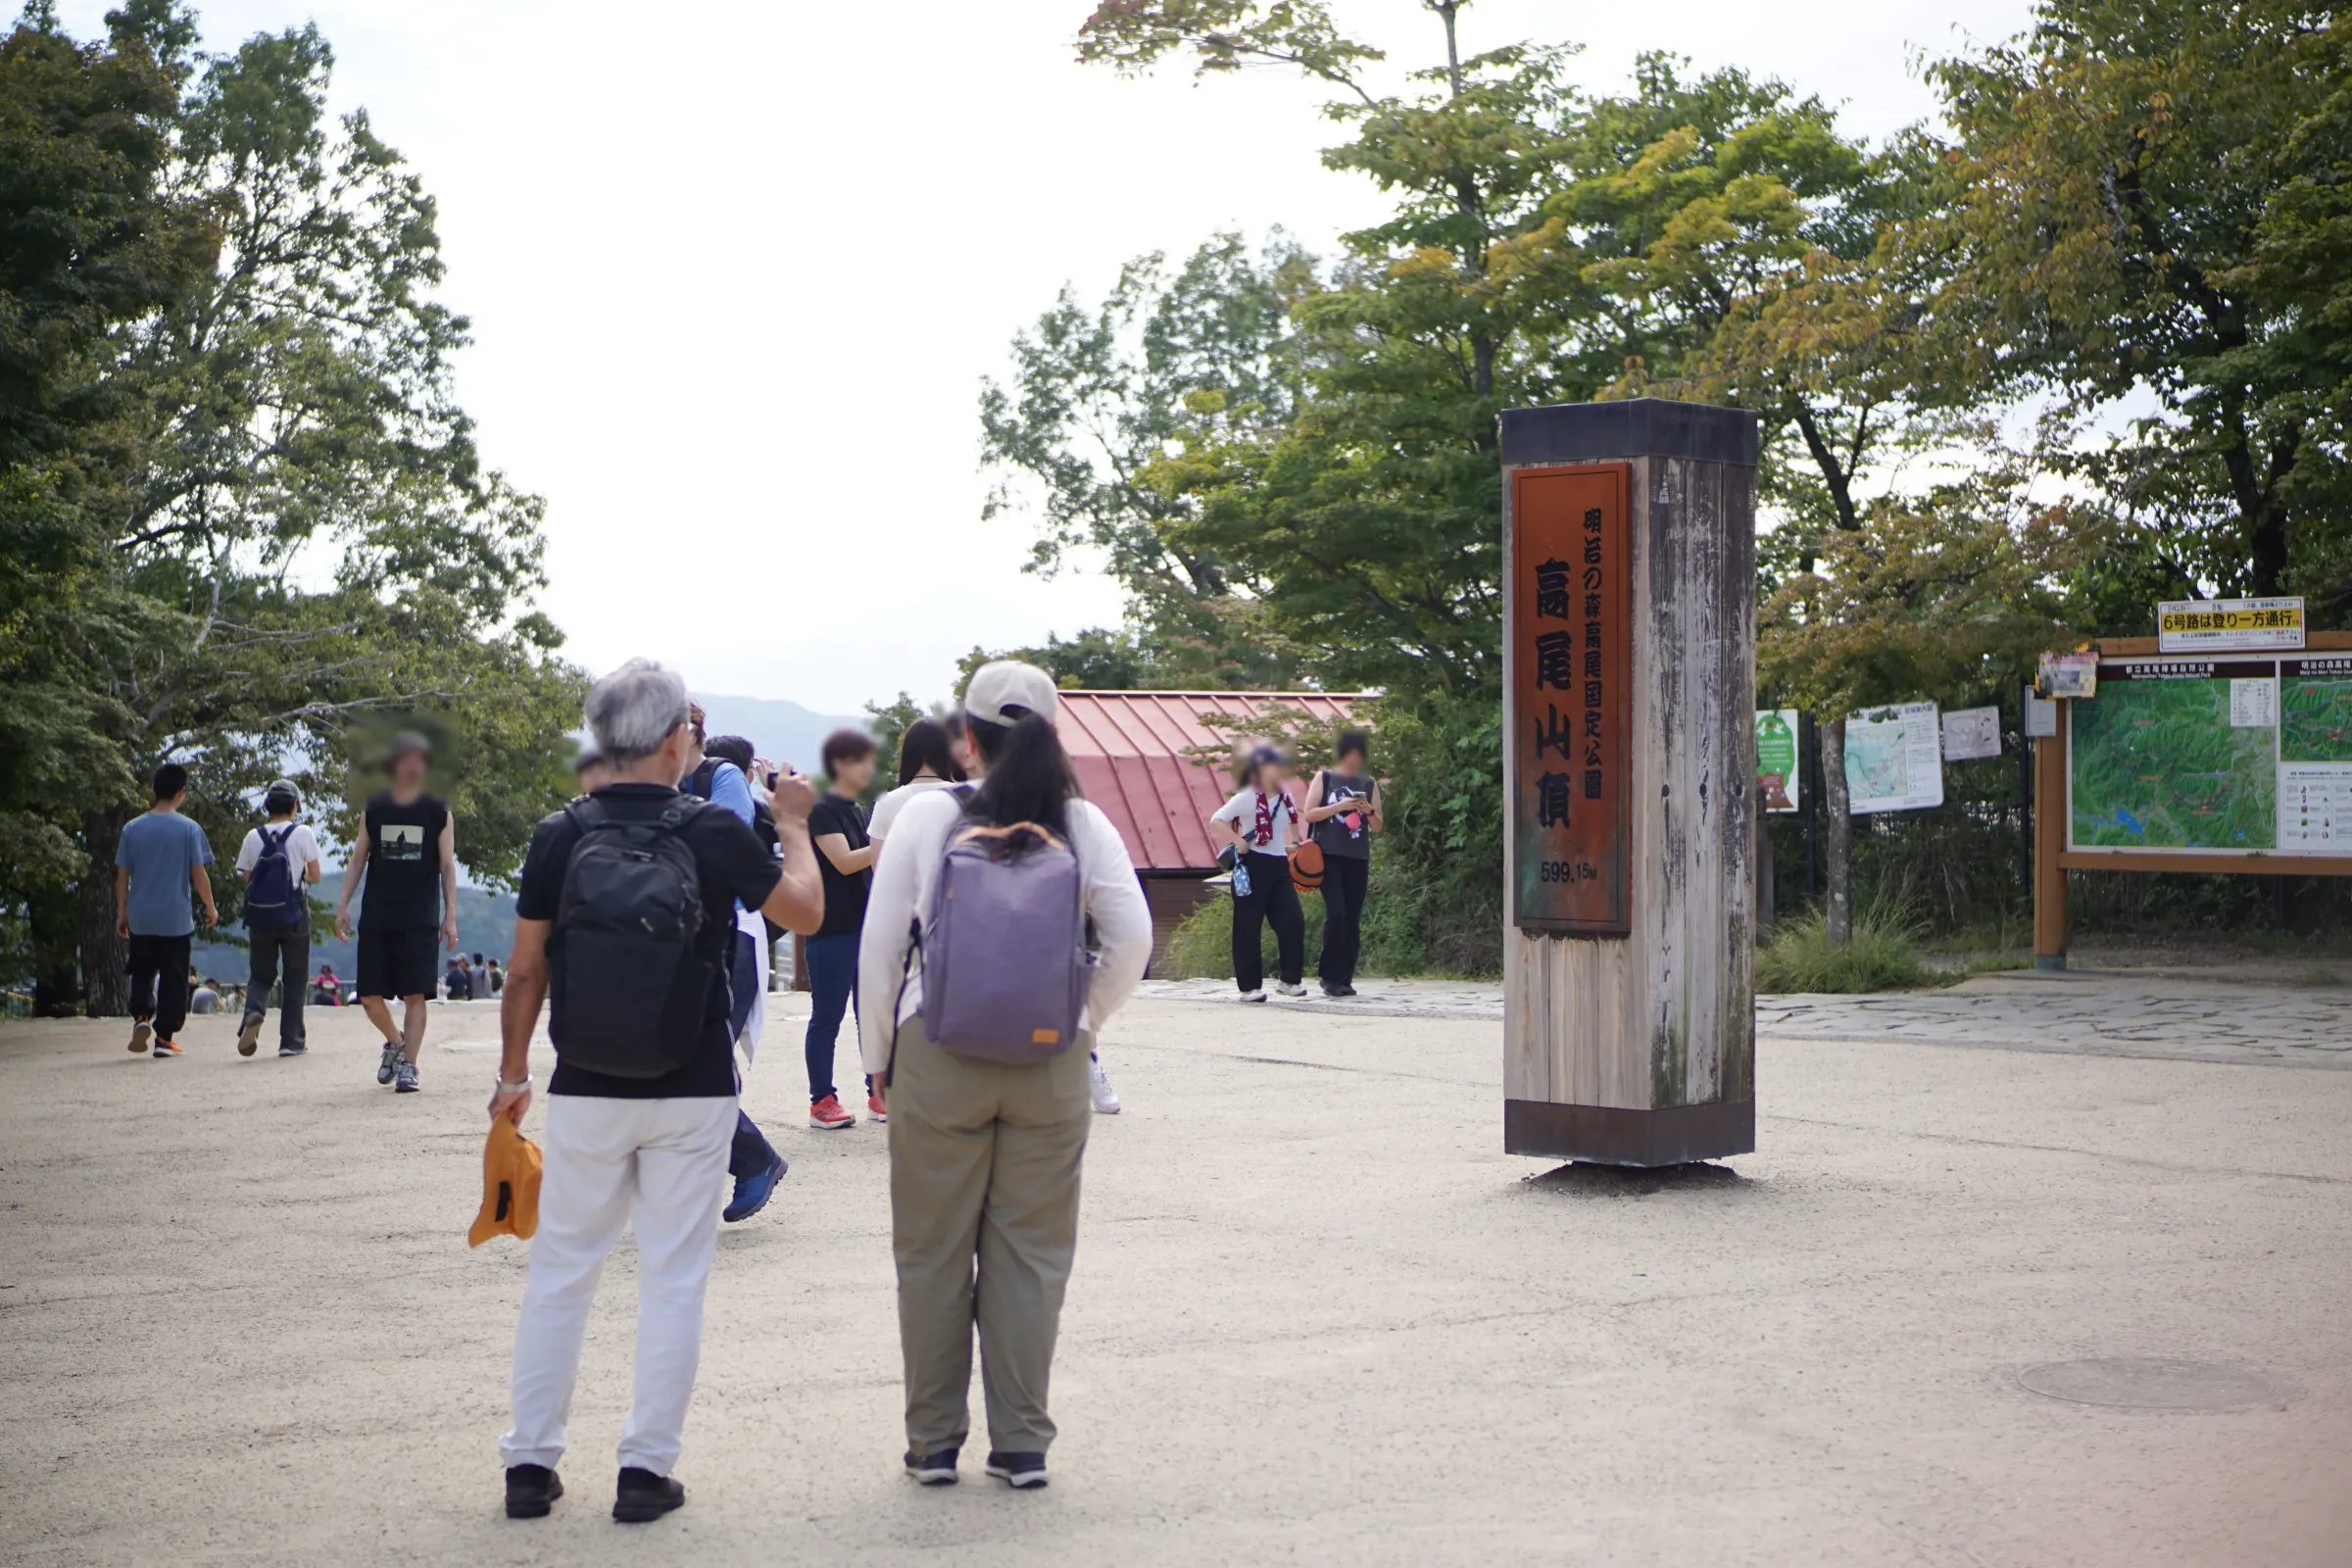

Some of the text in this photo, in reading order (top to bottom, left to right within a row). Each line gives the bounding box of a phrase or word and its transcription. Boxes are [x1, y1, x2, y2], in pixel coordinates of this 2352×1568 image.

[1535, 557, 1571, 829] 高尾山頂
[1582, 507, 1601, 799] 明治の森高尾国定公園
